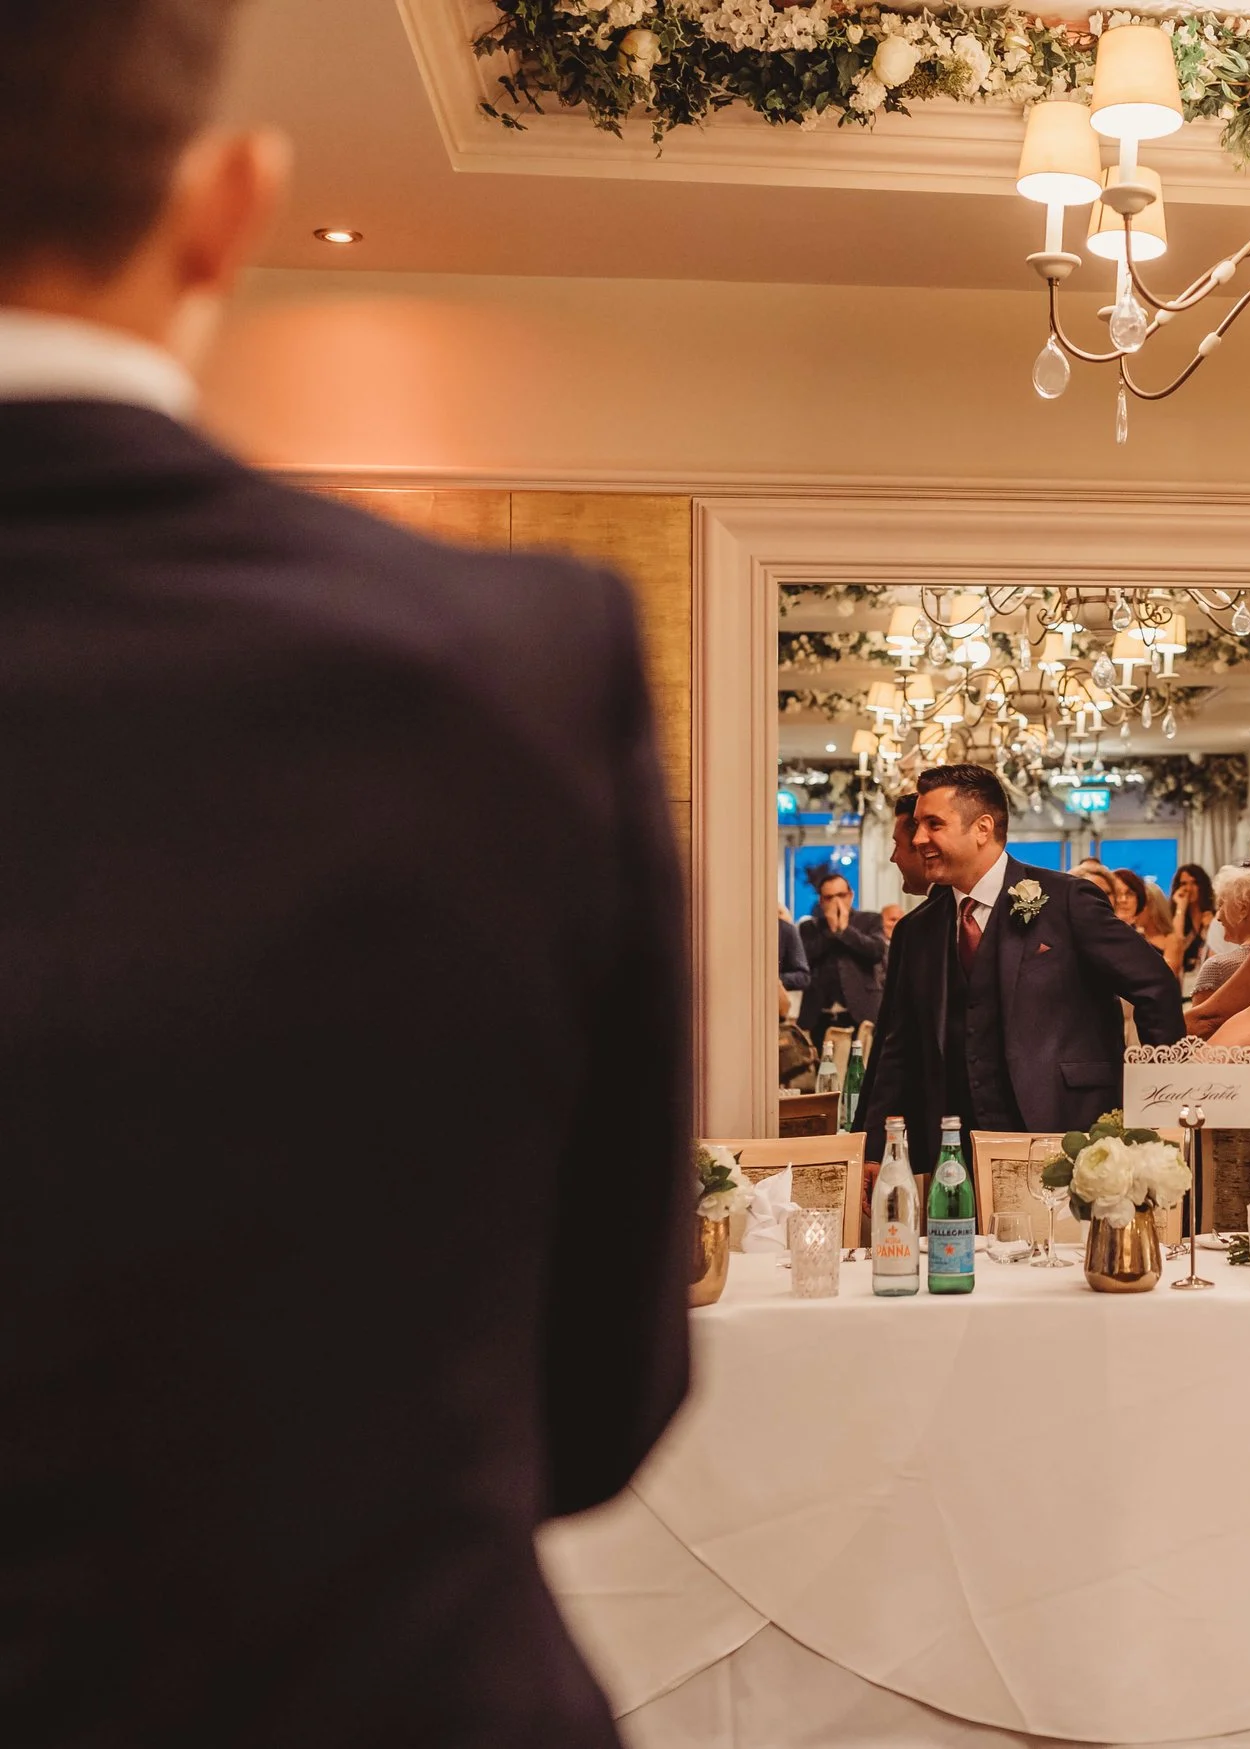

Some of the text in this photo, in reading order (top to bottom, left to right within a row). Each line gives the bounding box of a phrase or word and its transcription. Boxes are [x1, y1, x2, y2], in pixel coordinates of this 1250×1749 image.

[1141, 1082, 1241, 1112] Head Table
[876, 1243, 911, 1257] PANNA
